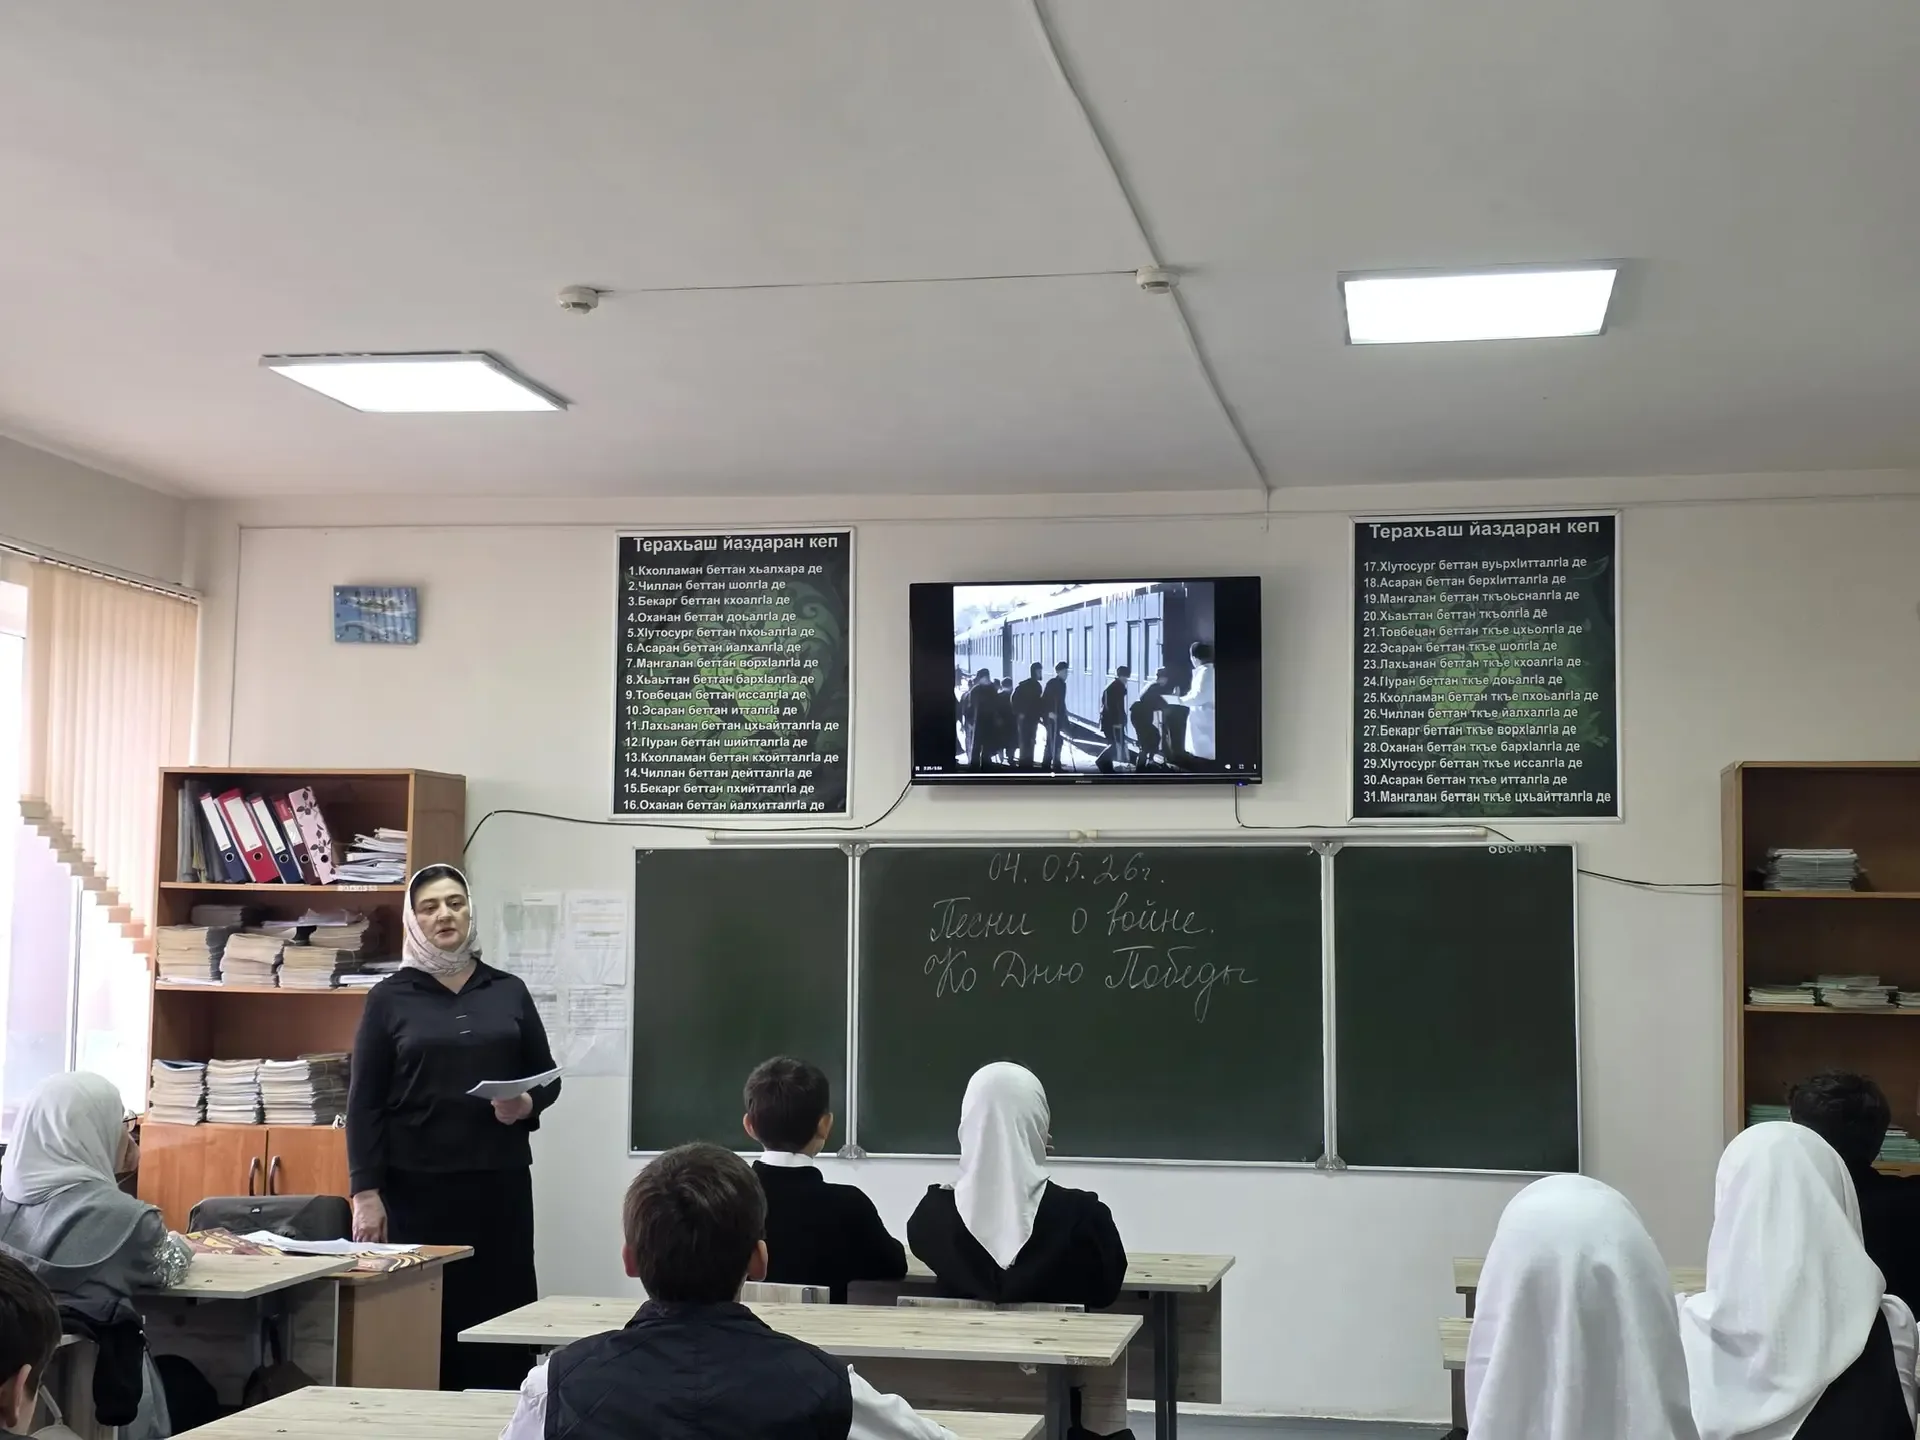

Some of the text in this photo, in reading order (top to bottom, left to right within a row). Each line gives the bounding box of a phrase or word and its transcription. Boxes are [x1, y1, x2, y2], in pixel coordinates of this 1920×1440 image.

[1369, 520, 1600, 541] Терахьаш йаздаран кеп
[633, 535, 838, 555] Терахьаш йаздаран кеп
[628, 564, 823, 576] 1.Кхолламан беттан хьалхара де
[1440, 560, 1478, 571] беттан
[1571, 558, 1587, 569] де
[628, 580, 682, 591] 2.Чиллан
[686, 579, 725, 590] беттан
[771, 580, 786, 591] де
[1364, 576, 1422, 588] 18.Асаран
[1426, 575, 1465, 586] беттан
[1552, 575, 1566, 584] де
[628, 595, 678, 608] 3.Бекарг
[680, 595, 720, 606] беттан
[775, 596, 790, 606] де
[1364, 592, 1436, 603] 19.Мангалан
[1439, 591, 1479, 601] беттан
[1564, 591, 1580, 600] де
[628, 611, 681, 623] 4.Оханан
[684, 611, 724, 622] беттан
[781, 612, 796, 622] де
[1364, 609, 1433, 620] 20.Хьаьттан
[1436, 609, 1476, 619] беттан
[1532, 609, 1548, 619] де
[696, 626, 736, 637] беттан
[800, 627, 815, 638] де
[1363, 626, 1436, 638] 21.Товбецан
[1439, 625, 1478, 635] беттан
[1482, 627, 1509, 635] ткъе
[1567, 625, 1582, 635] де
[626, 642, 680, 655] 6.Асаран
[683, 642, 722, 653] беттан
[786, 643, 801, 654] де
[1364, 642, 1422, 654] 22.Эсаран
[1426, 641, 1465, 652] беттан
[1468, 643, 1496, 651] ткъе
[1542, 642, 1557, 651] де
[627, 657, 693, 668] 7.Мангалан
[696, 657, 736, 668] беттан
[803, 658, 818, 669] де
[1364, 658, 1436, 669] 23.Лахьанан
[1440, 657, 1479, 668] беттан
[1483, 659, 1510, 667] ткъе
[1566, 658, 1581, 667] де
[626, 674, 690, 685] 8.Хьаьттан
[693, 674, 732, 684] беттан
[799, 675, 814, 685] де
[1420, 675, 1458, 686] беттан
[1462, 677, 1488, 685] ткъе
[1548, 676, 1562, 685] де
[626, 689, 692, 701] 9.Товбецан
[696, 689, 734, 700] беттан
[792, 691, 806, 701] де
[1364, 692, 1444, 702] 25.Кхолламан
[1448, 691, 1487, 701] беттан
[1491, 693, 1518, 701] ткъе
[1584, 692, 1598, 701] де
[626, 705, 685, 717] 10.Эсаран
[688, 704, 728, 715] беттан
[782, 706, 798, 716] де
[1364, 708, 1424, 718] 26.Чиллан
[1428, 708, 1467, 718] беттан
[1471, 709, 1498, 717] ткъе
[1564, 709, 1578, 718] де
[626, 720, 698, 731] 11.Лахьанан
[701, 720, 741, 731] беттан
[824, 721, 839, 731] де
[1364, 725, 1420, 737] 27.Бекарг
[1423, 725, 1462, 735] беттан
[1466, 726, 1494, 734] ткъе
[1562, 725, 1576, 735] де
[680, 736, 720, 747] беттан
[792, 738, 808, 748] де
[1364, 742, 1423, 752] 28.Оханан
[1427, 741, 1466, 751] беттан
[1470, 743, 1497, 751] ткъе
[1565, 742, 1580, 752] де
[625, 752, 706, 763] 13.Кхолламан
[709, 752, 749, 762] беттан
[824, 753, 839, 764] де
[1440, 757, 1479, 767] беттан
[1483, 759, 1510, 767] ткъе
[1568, 759, 1582, 768] де
[624, 768, 685, 778] 14.Чиллан
[688, 767, 728, 778] беттан
[797, 769, 812, 779] де
[1364, 774, 1423, 786] 30.Асаран
[1426, 774, 1466, 784] беттан
[1469, 776, 1497, 784] ткъе
[1552, 775, 1568, 785] де
[624, 783, 681, 795] 15.Бекарг
[683, 783, 723, 793] беттан
[799, 784, 815, 794] де
[1364, 791, 1437, 802] 31.Мангалан
[1441, 790, 1480, 801] беттан
[1484, 792, 1511, 801] ткъе
[1596, 791, 1611, 802] де
[624, 800, 683, 810] 16.Оханан
[686, 799, 726, 810] беттан
[810, 801, 825, 811] де
[929, 897, 1035, 942] Песни
[924, 945, 1258, 1023] Ко Дню Победы
